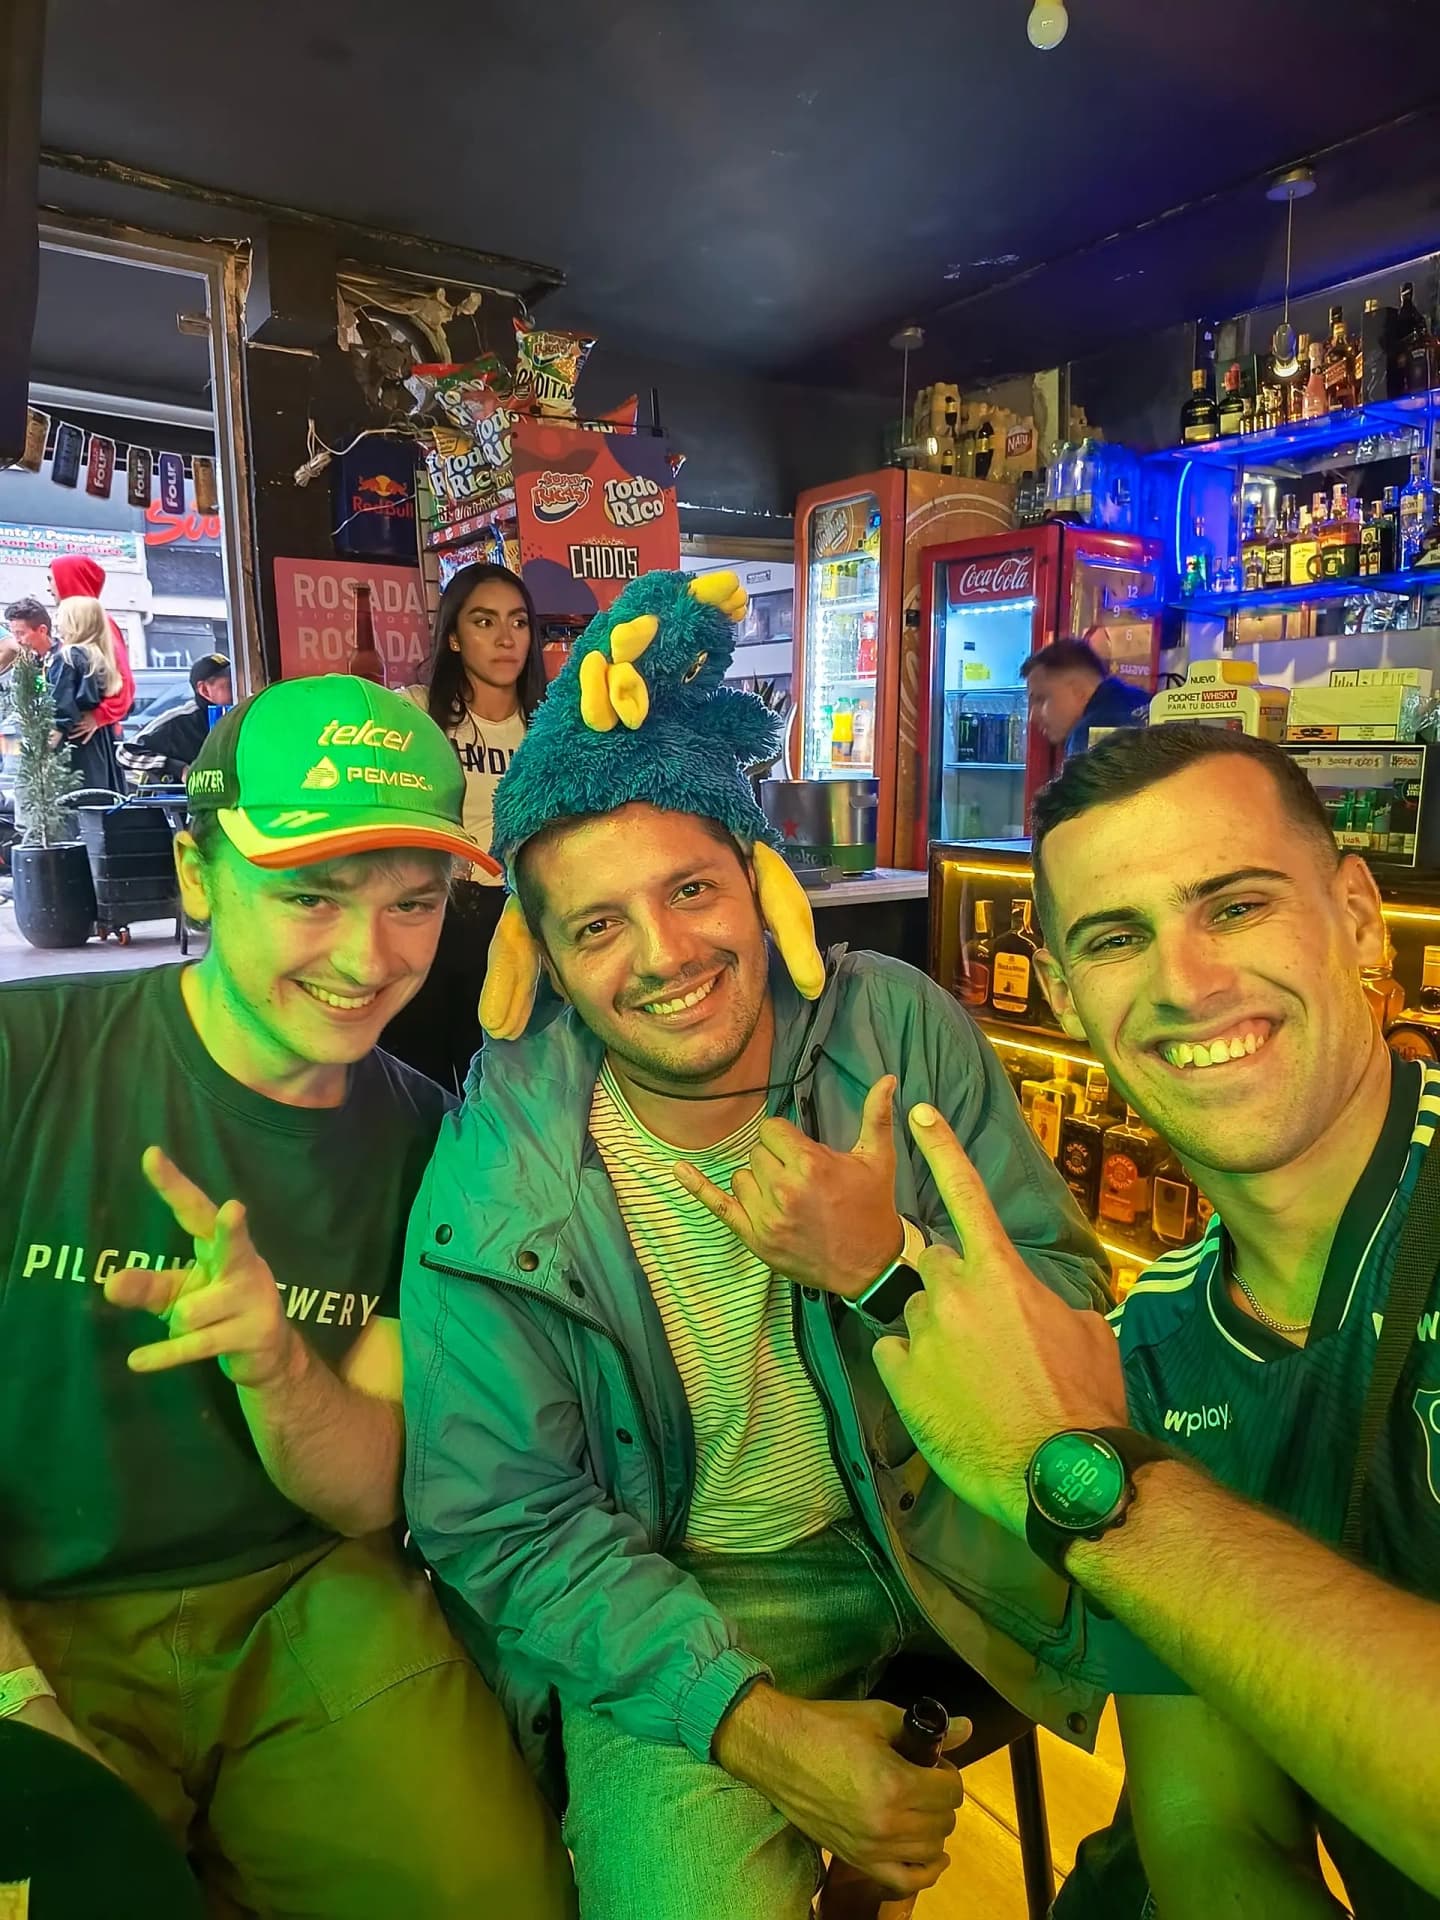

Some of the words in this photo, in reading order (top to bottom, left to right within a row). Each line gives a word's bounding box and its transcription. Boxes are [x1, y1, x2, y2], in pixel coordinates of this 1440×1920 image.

[135, 459, 146, 498] four
[166, 461, 178, 508] four
[449, 467, 492, 498] Ric
[604, 476, 659, 502] Todo
[384, 500, 414, 518] Bull
[610, 498, 664, 526] Rico
[569, 545, 639, 579] CHIDOS
[1127, 585, 1138, 599] 12
[298, 626, 425, 664] ROSDA
[1190, 675, 1216, 685] NUEVO
[1167, 692, 1201, 703] POCKET
[1202, 690, 1237, 701] WHISKY
[1188, 702, 1199, 710] TU
[1200, 701, 1237, 710] BOLSILLO
[317, 719, 414, 752] telcel
[347, 767, 427, 791] PEMEX
